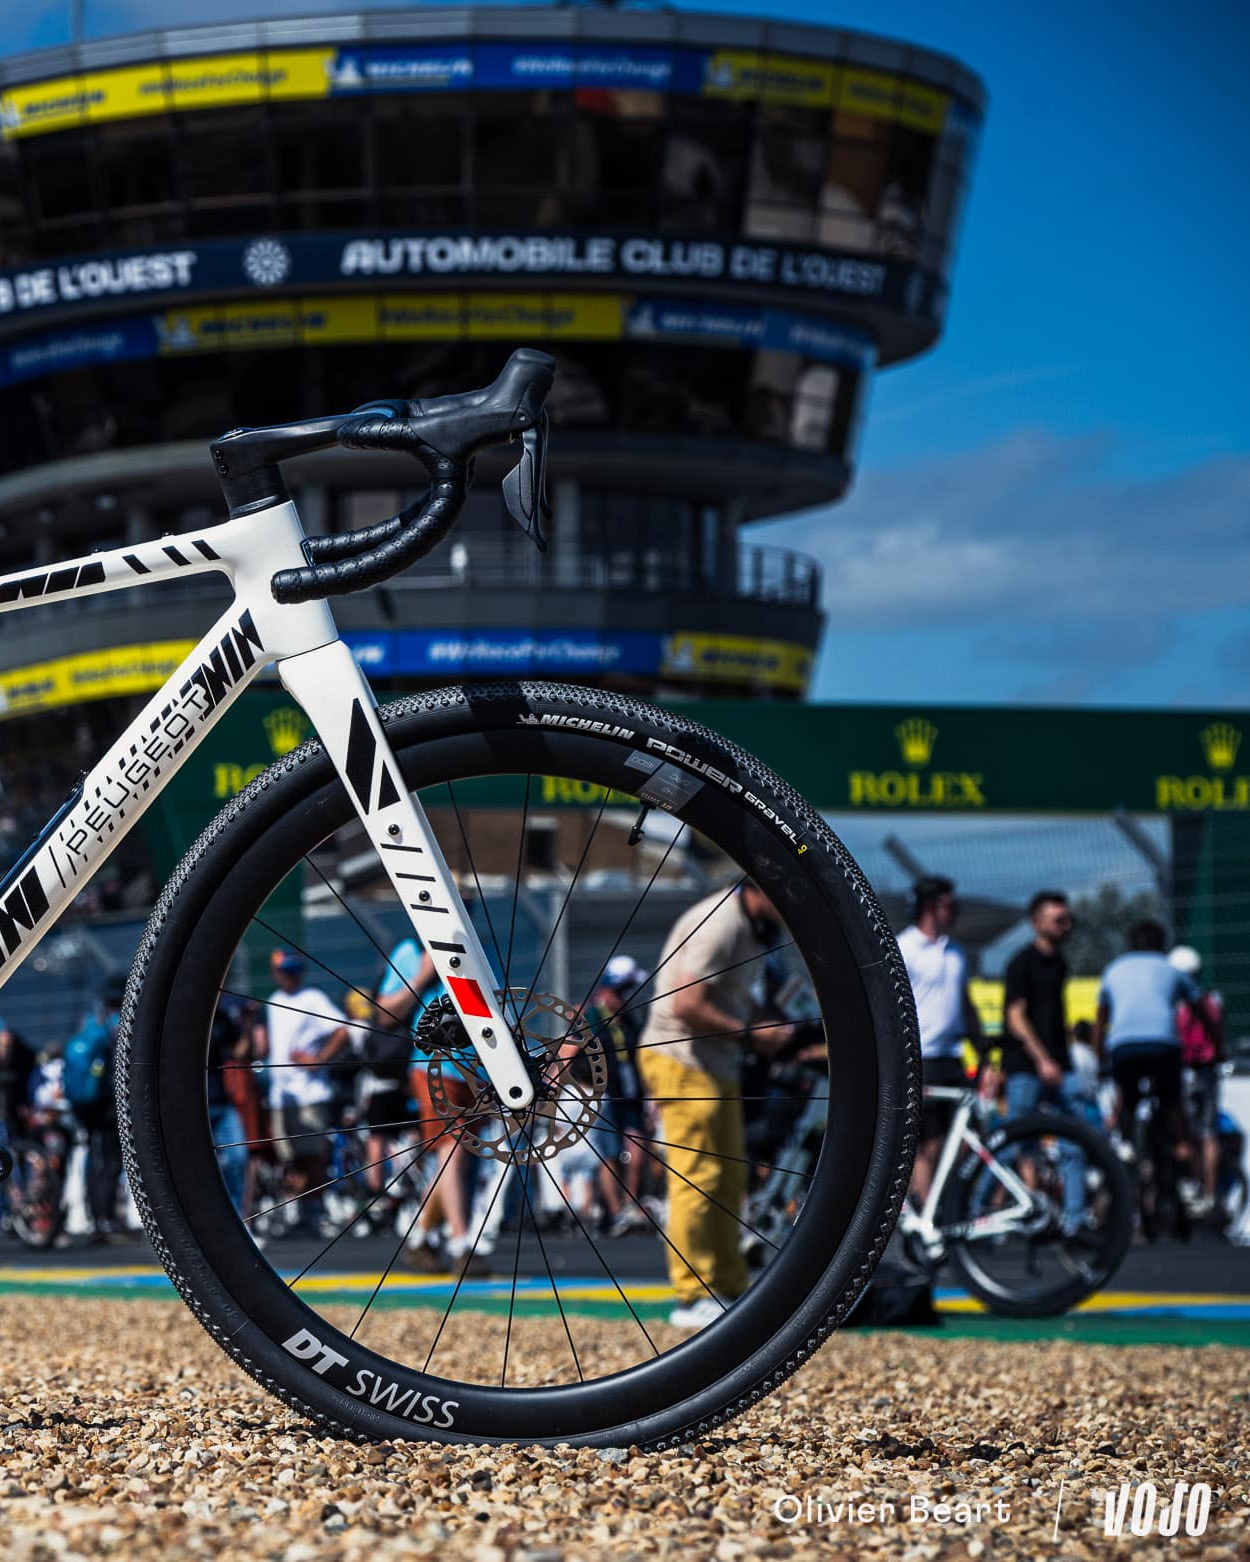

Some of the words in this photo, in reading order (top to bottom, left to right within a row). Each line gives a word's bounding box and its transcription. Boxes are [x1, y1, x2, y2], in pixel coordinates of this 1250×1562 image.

[14, 269, 59, 307] DE
[340, 236, 616, 275] AUTOMOBILE
[620, 239, 724, 276] CLUB
[729, 246, 776, 280] DE
[66, 689, 205, 856] PEUGEOT
[540, 713, 635, 740] MICHELIN
[646, 737, 743, 794] POWER
[850, 770, 986, 806] ROLEX
[281, 1328, 350, 1375] DT
[345, 1369, 460, 1428] SWISS
